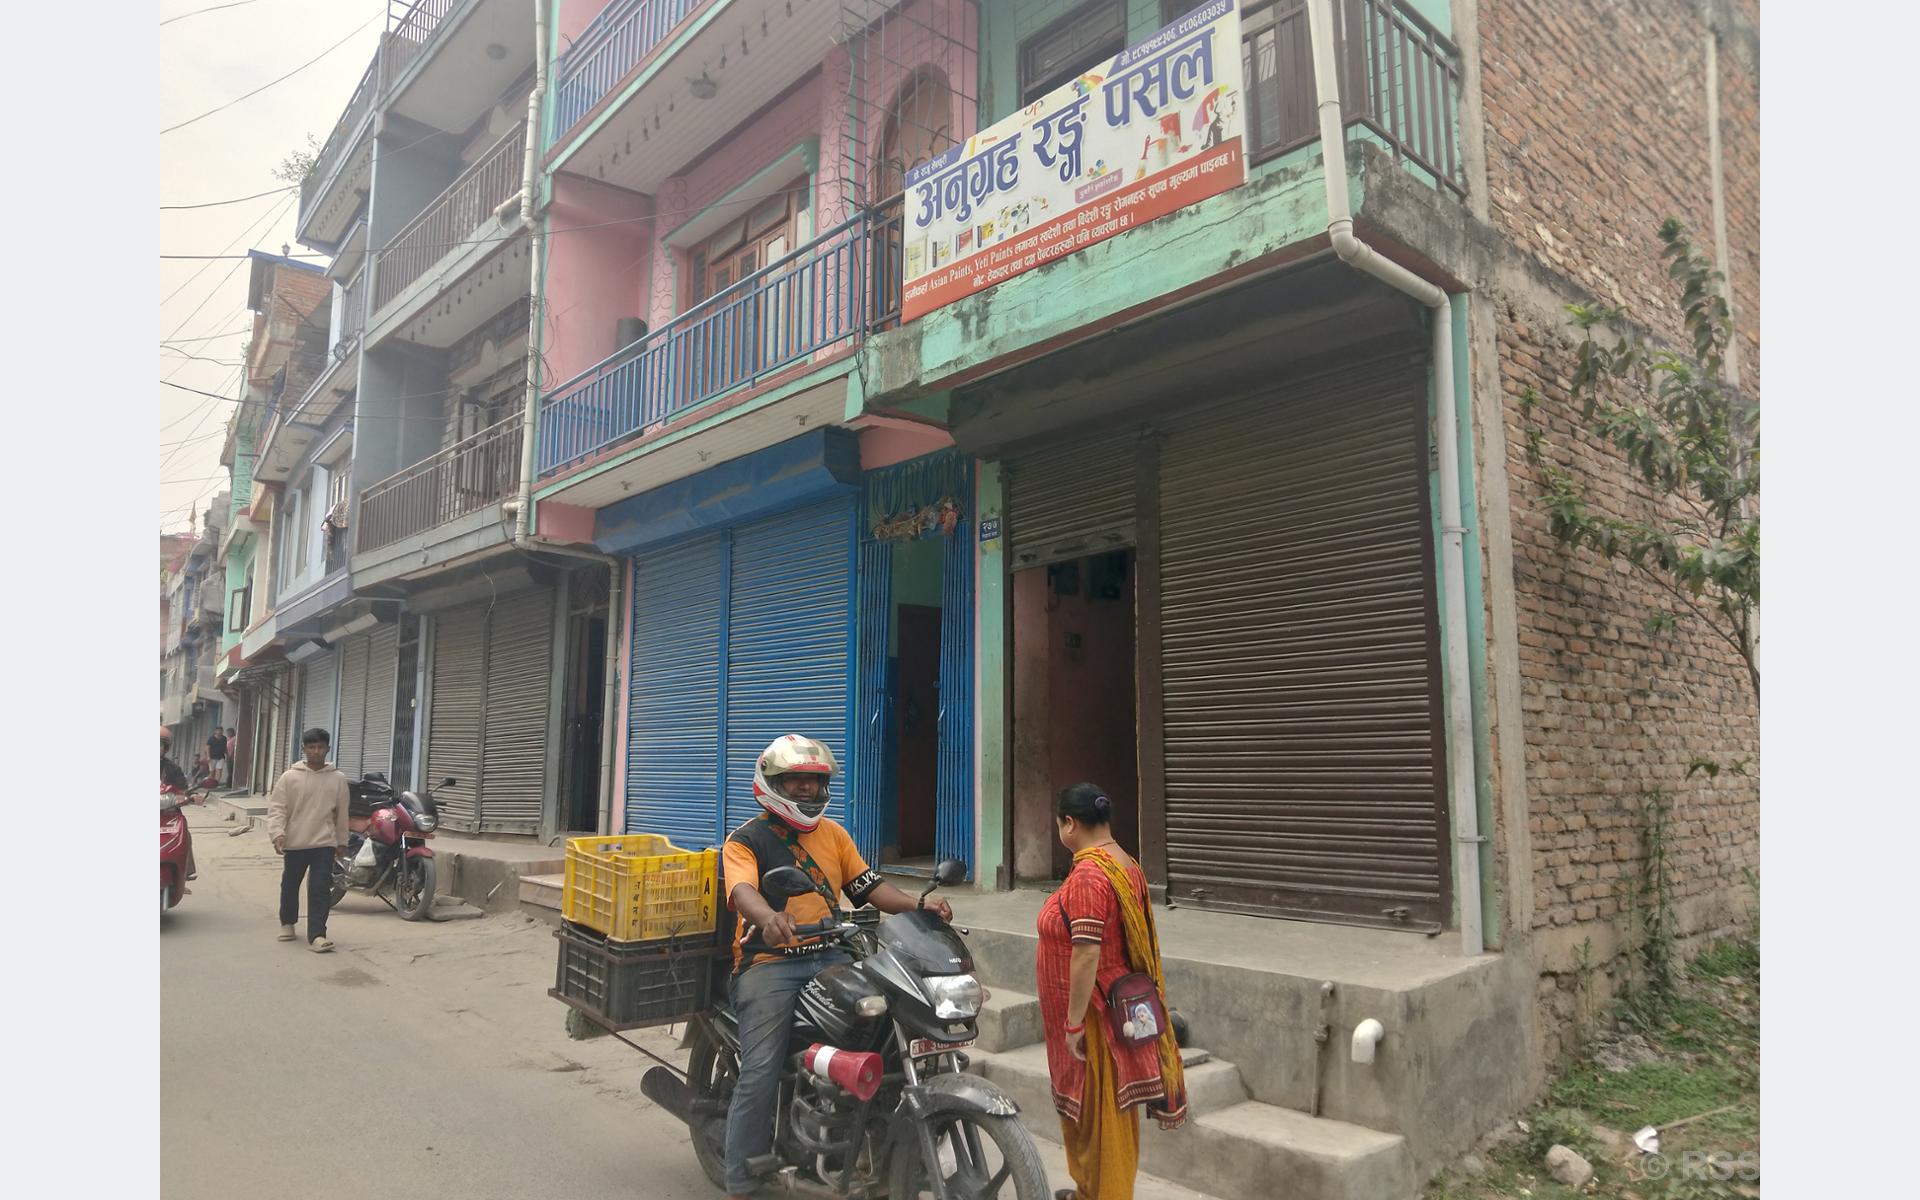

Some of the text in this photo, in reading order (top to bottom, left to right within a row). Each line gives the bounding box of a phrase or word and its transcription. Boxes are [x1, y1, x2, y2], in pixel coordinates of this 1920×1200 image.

[916, 132, 1021, 228] अनुग्रह
[1102, 27, 1216, 127] पसल
[929, 273, 948, 291] Asian
[949, 264, 973, 286] Paints,
[974, 256, 989, 271] Yeti
[990, 247, 1013, 264] Paints
[702, 877, 710, 922] A S
